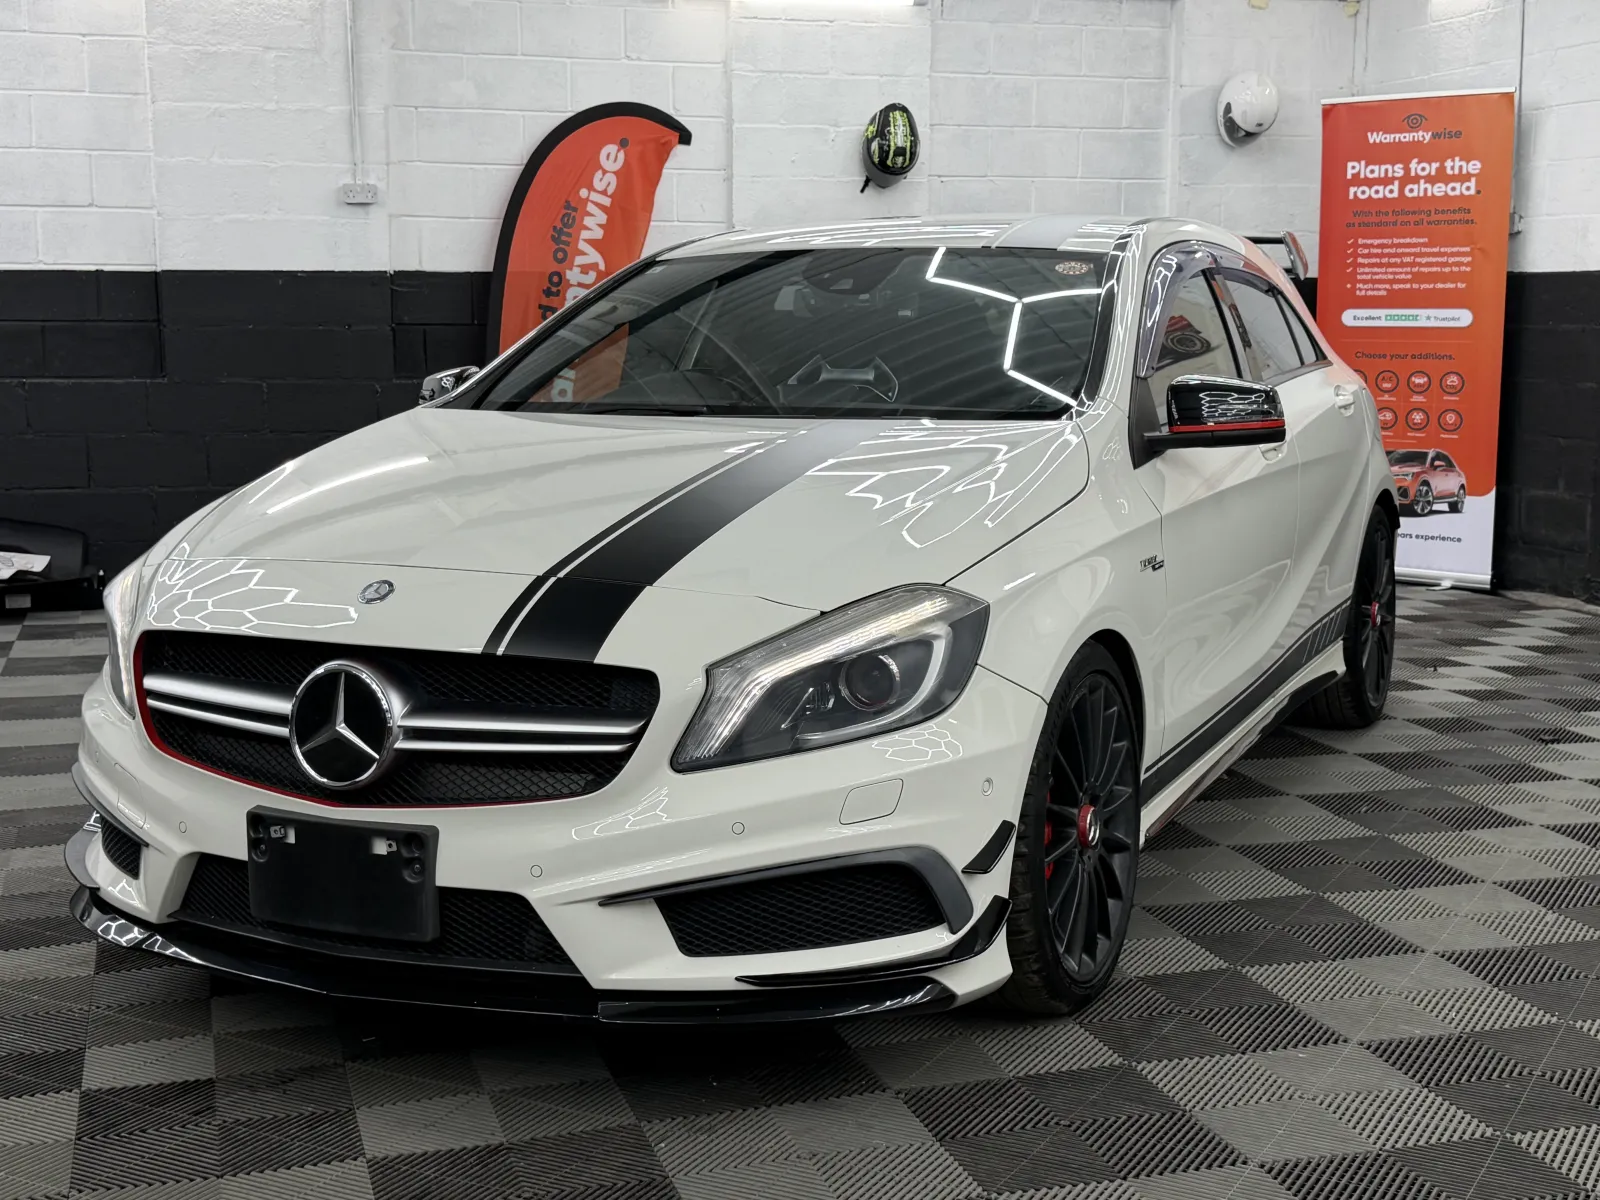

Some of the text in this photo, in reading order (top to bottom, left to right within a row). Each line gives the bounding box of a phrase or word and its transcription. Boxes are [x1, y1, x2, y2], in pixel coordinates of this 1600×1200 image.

[1367, 128, 1463, 144] Warrantywise
[1346, 156, 1482, 179] Plans for the
[1348, 176, 1482, 200] road ahead.
[1352, 206, 1471, 218] With the following benefits
[1358, 219, 1398, 228] standard
[1413, 218, 1424, 226] all
[1426, 217, 1477, 226] warranties.
[551, 200, 579, 264] offer
[1358, 238, 1393, 246] Emergency
[1448, 256, 1472, 264] garage
[542, 271, 563, 298] to
[1354, 351, 1455, 361] Choose your additions.
[1415, 533, 1462, 543] experience
